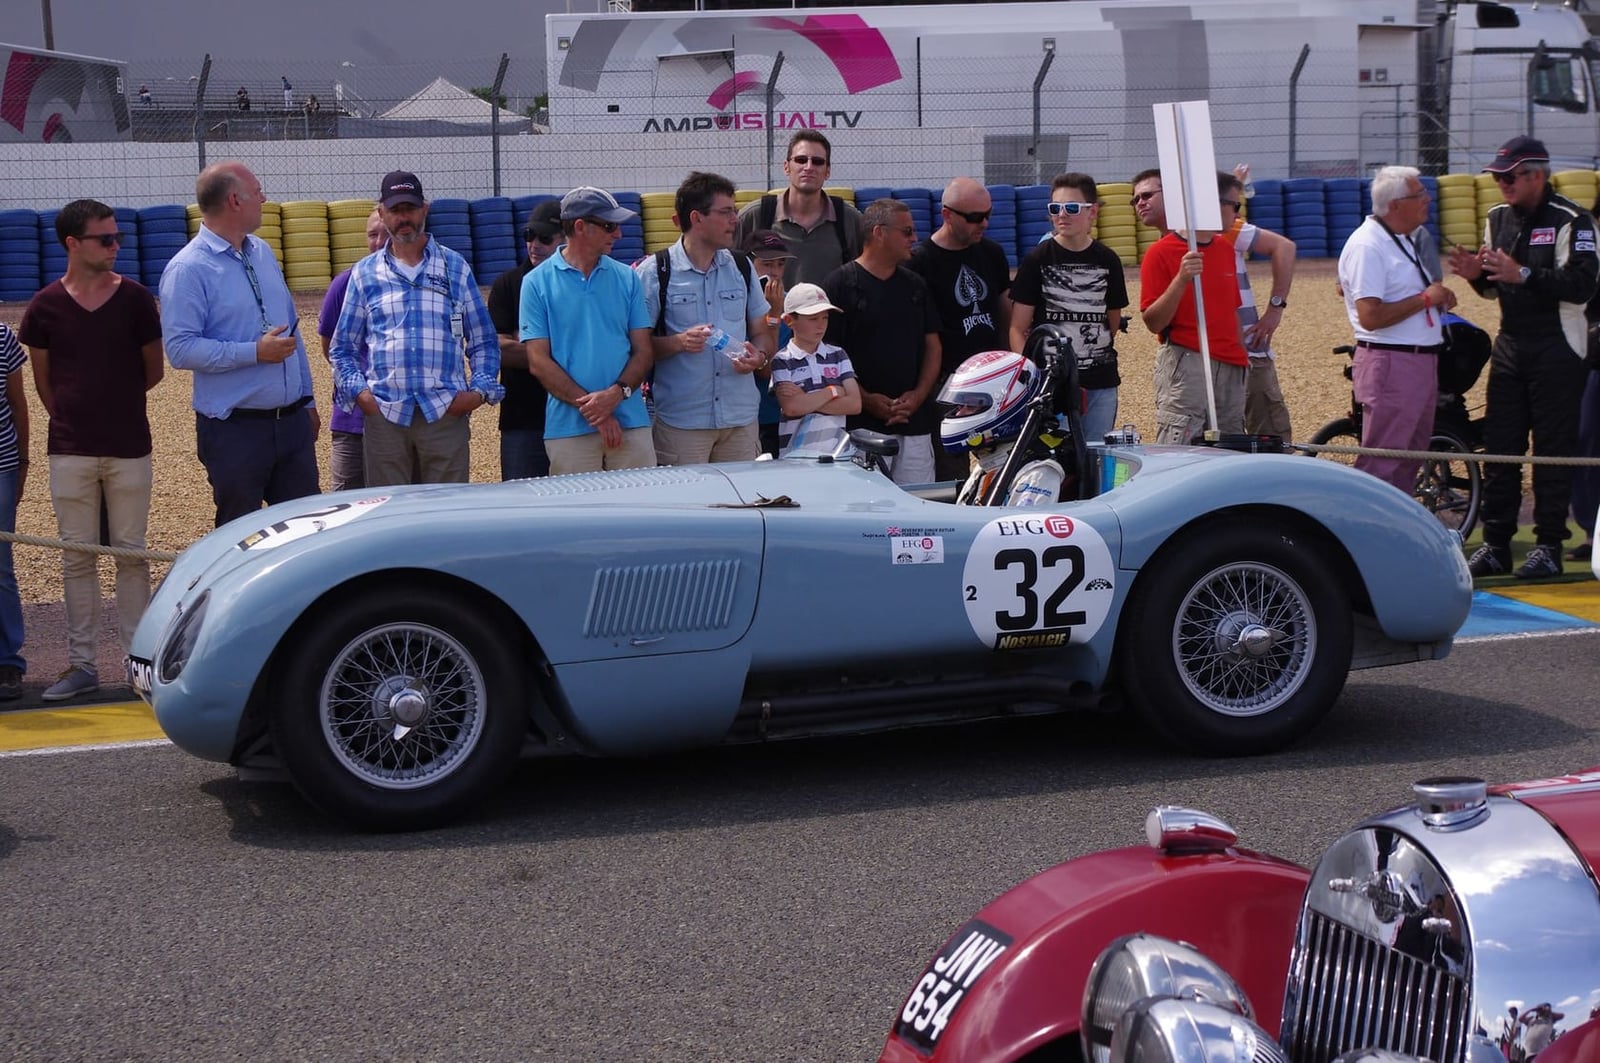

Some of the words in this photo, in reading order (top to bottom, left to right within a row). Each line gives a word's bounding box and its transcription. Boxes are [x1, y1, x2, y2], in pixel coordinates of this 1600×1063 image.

[997, 519, 1044, 536] EFG
[965, 585, 977, 601] 2
[994, 544, 1087, 631] 32
[998, 632, 1067, 650] NOSTALGIE
[934, 930, 1007, 988] JNV
[902, 972, 964, 1041] 654
